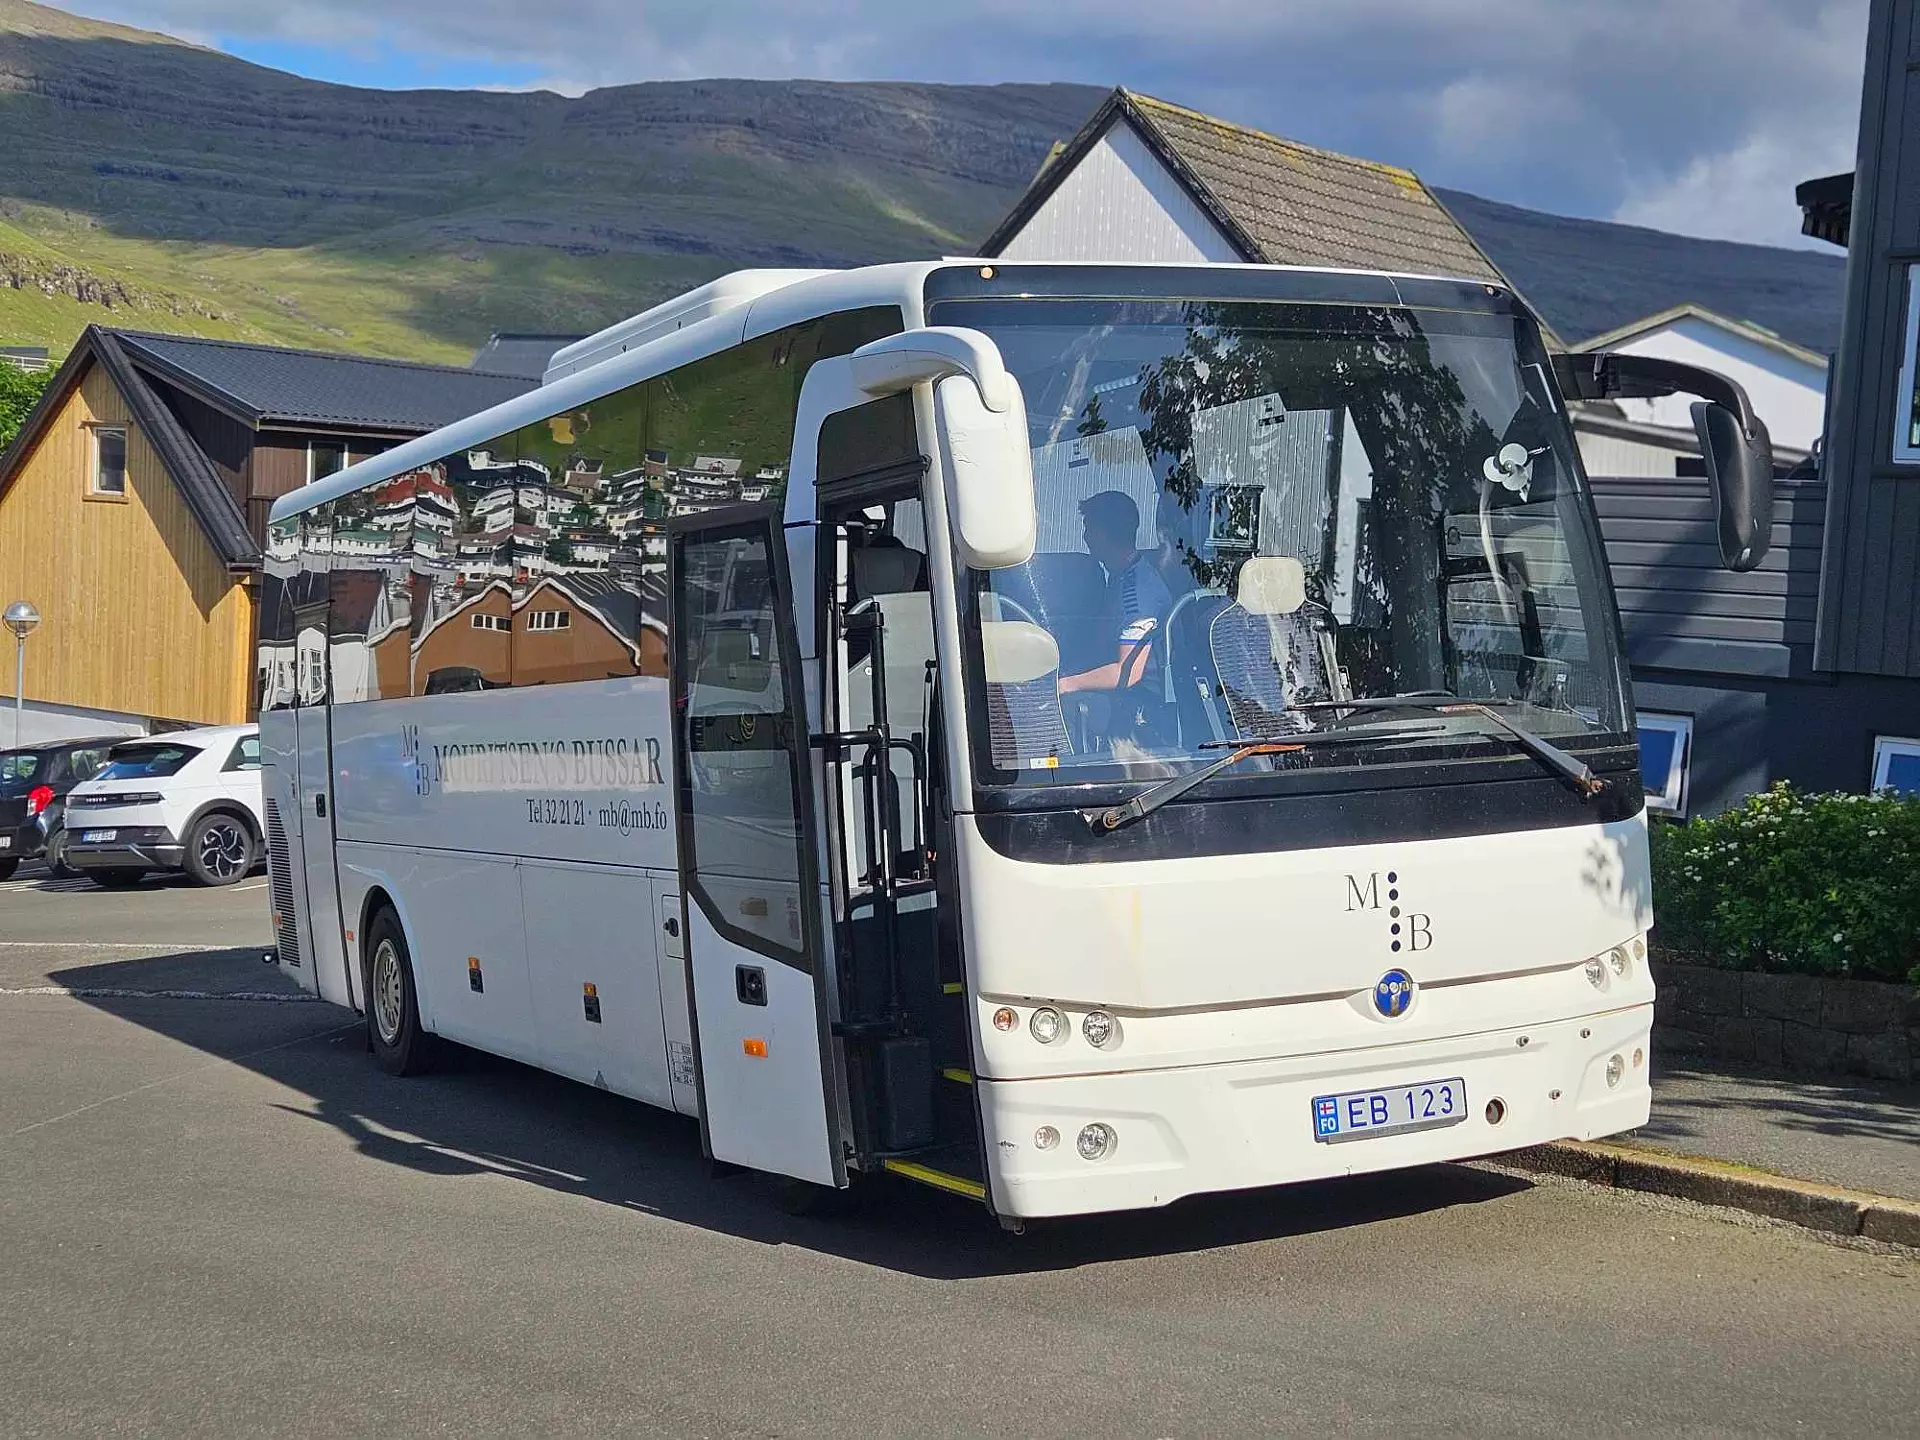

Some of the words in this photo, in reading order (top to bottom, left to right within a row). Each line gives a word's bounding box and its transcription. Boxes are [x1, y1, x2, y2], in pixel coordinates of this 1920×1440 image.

[572, 738, 665, 785] BUSSAR
[527, 799, 543, 823] Tel
[599, 800, 667, 836] mb@mb.fo
[1344, 872, 1382, 911] M
[1406, 914, 1433, 951] B
[1321, 1117, 1336, 1132] FO
[1347, 1095, 1389, 1128] EB
[1405, 1086, 1453, 1119] 123
